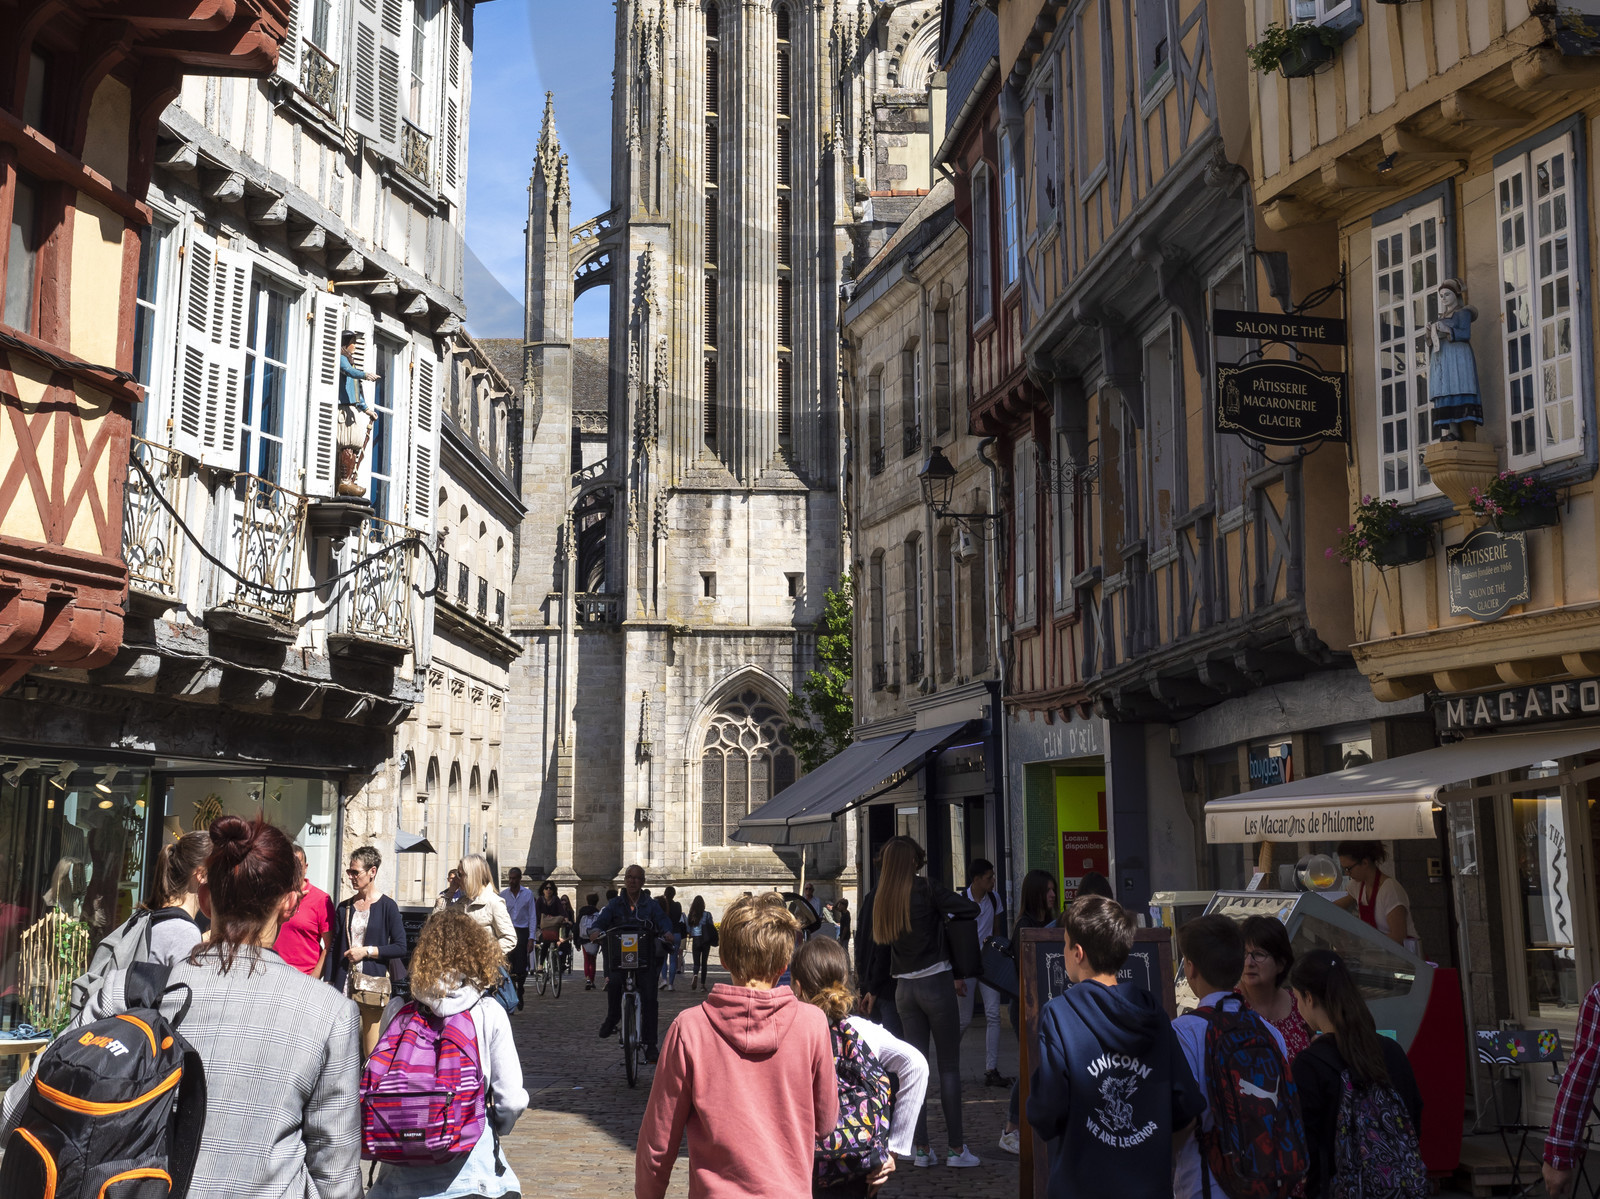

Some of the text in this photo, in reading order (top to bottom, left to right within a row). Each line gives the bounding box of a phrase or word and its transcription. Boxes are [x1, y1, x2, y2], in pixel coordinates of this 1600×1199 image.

[1235, 321, 1326, 339] SALON DE THÉ
[1253, 378, 1308, 395] PÂTISSERIE
[1243, 394, 1318, 412] MACARONERIE
[1258, 413, 1302, 428] GLACIER
[1461, 544, 1508, 567] PÂTISSERIE
[1469, 585, 1486, 599] SALON
[1486, 583, 1494, 596] DE
[1477, 598, 1500, 611] GLACIER
[1446, 680, 1600, 728] MACARO
[1249, 752, 1279, 784] bouygues
[1244, 815, 1258, 835] Les
[1308, 811, 1320, 834] de
[1321, 809, 1375, 833] Philomène
[1064, 834, 1089, 842] Locaux
[1065, 842, 1104, 851] disponibles
[1086, 1052, 1153, 1079] UNICORN
[1086, 1115, 1158, 1149] WE ARE LEGENDS
